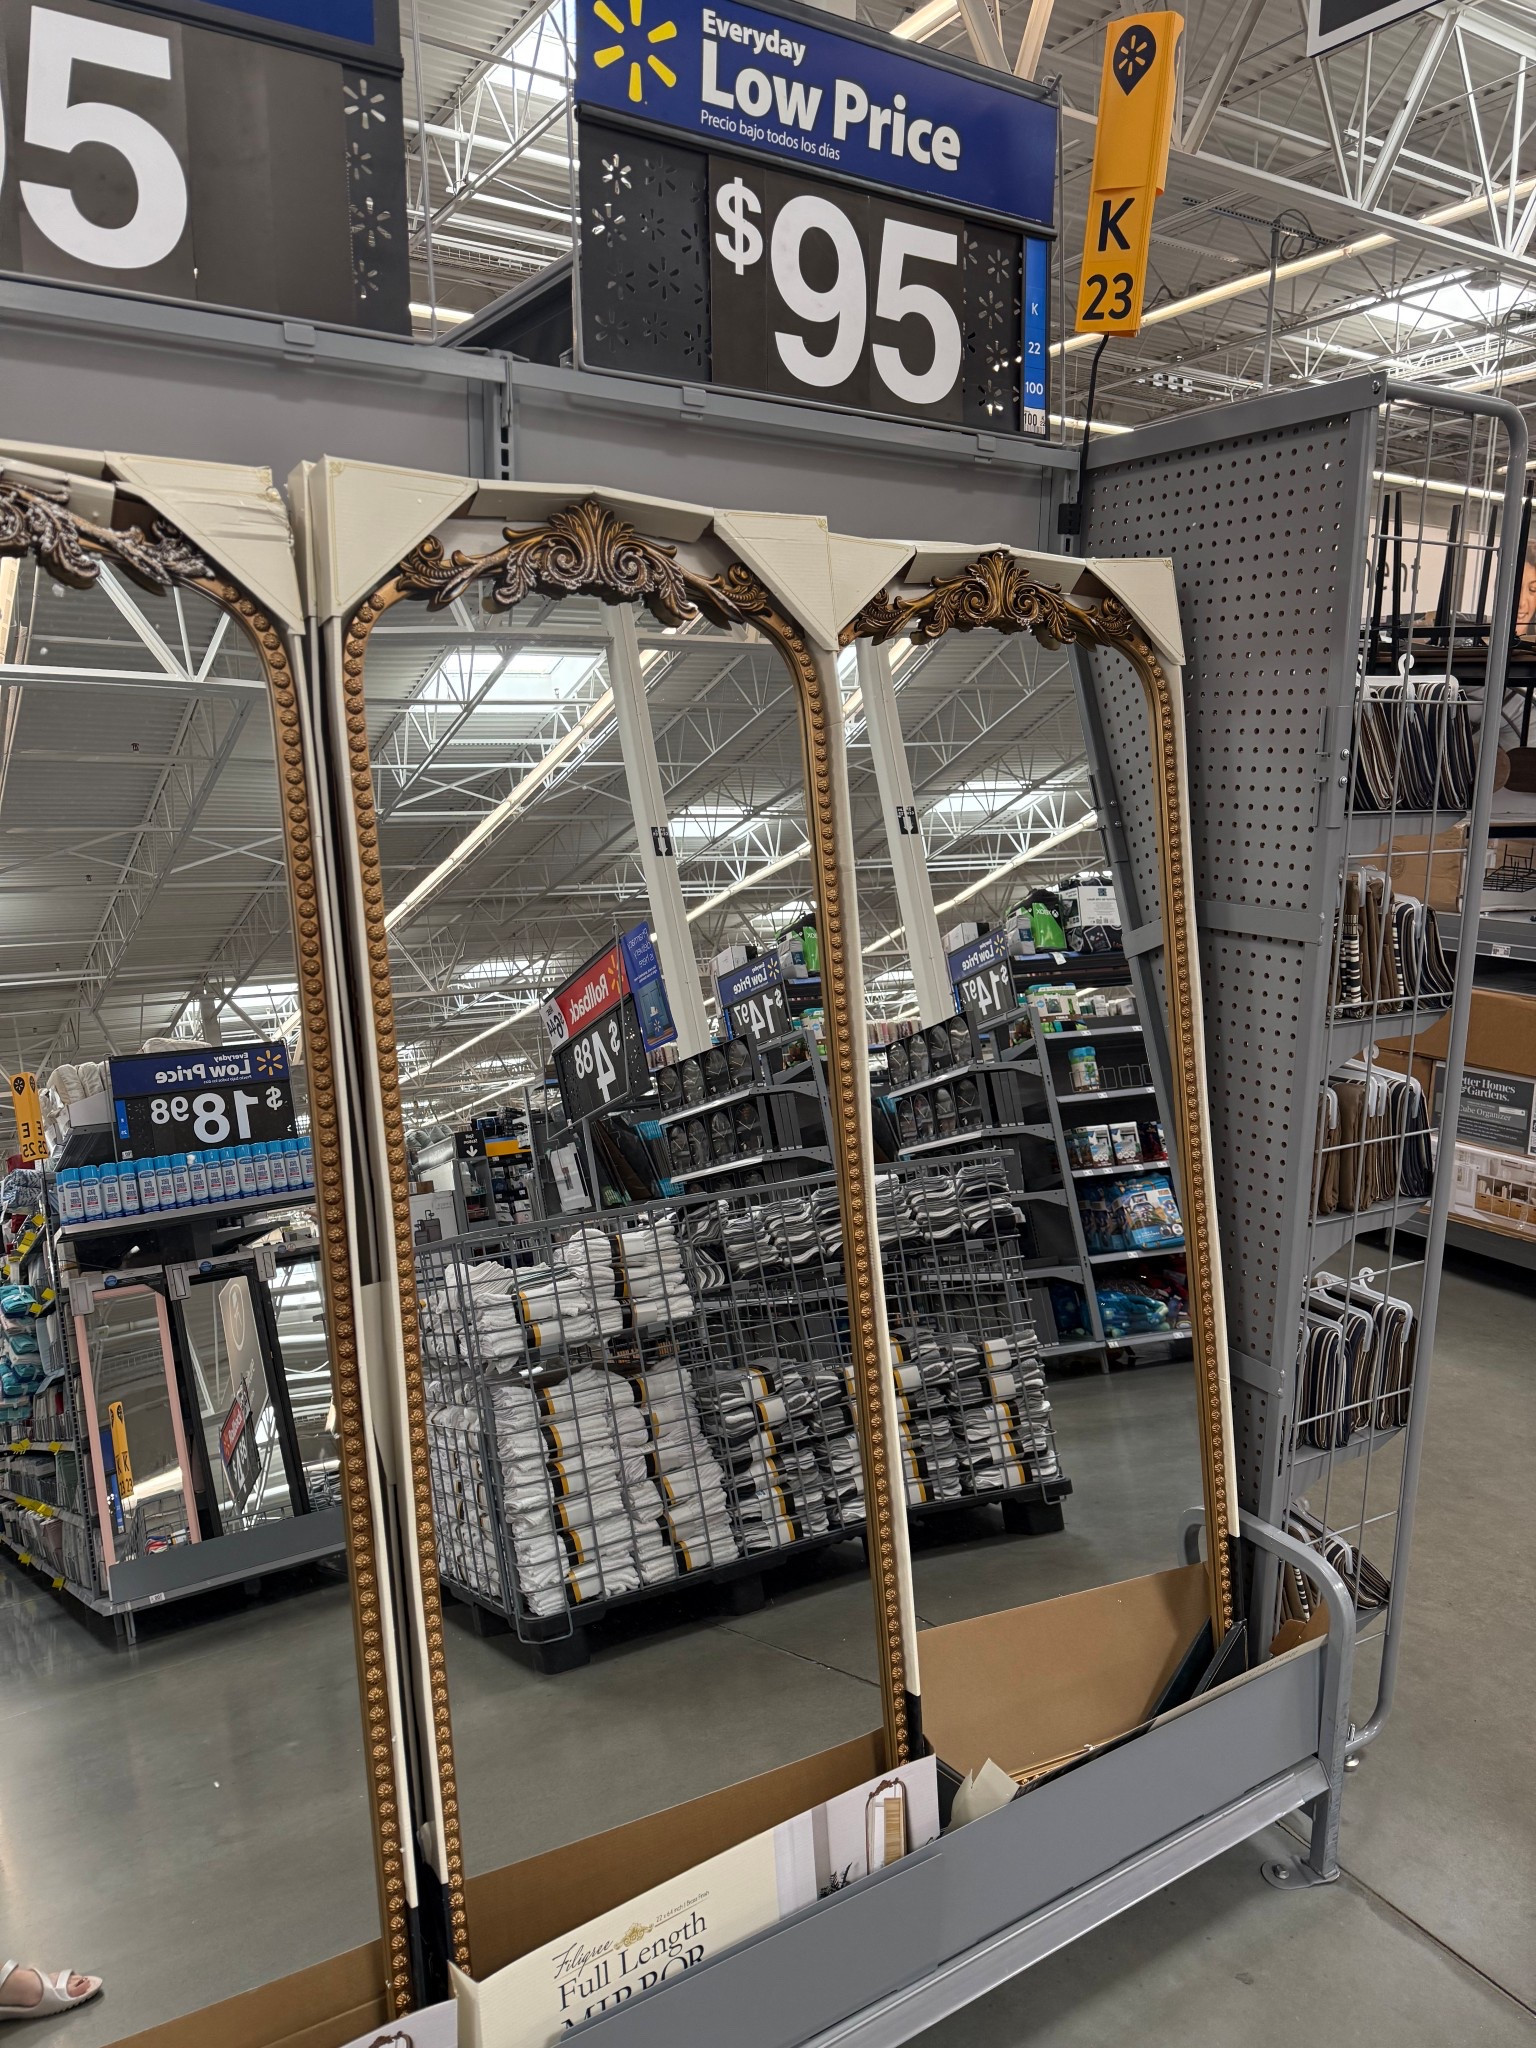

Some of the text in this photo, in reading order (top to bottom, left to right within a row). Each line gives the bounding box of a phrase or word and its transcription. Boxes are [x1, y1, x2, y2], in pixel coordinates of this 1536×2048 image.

[702, 8, 806, 67] Everyday
[701, 38, 961, 171] Low Price
[0, 4, 188, 270] 5
[700, 109, 841, 161] Precio bajo todos los días
[1097, 197, 1136, 252] K
[1031, 302, 1039, 316] K
[1082, 272, 1134, 321] 23
[1028, 341, 1041, 355] 22
[1025, 382, 1044, 395] 100
[1482, 1079, 1516, 1094] Homes
[1476, 1108, 1512, 1122] Organizer
[552, 1940, 614, 1979] Filigree
[558, 1911, 708, 2012] Full Length
[560, 1944, 705, 2030] RROR
